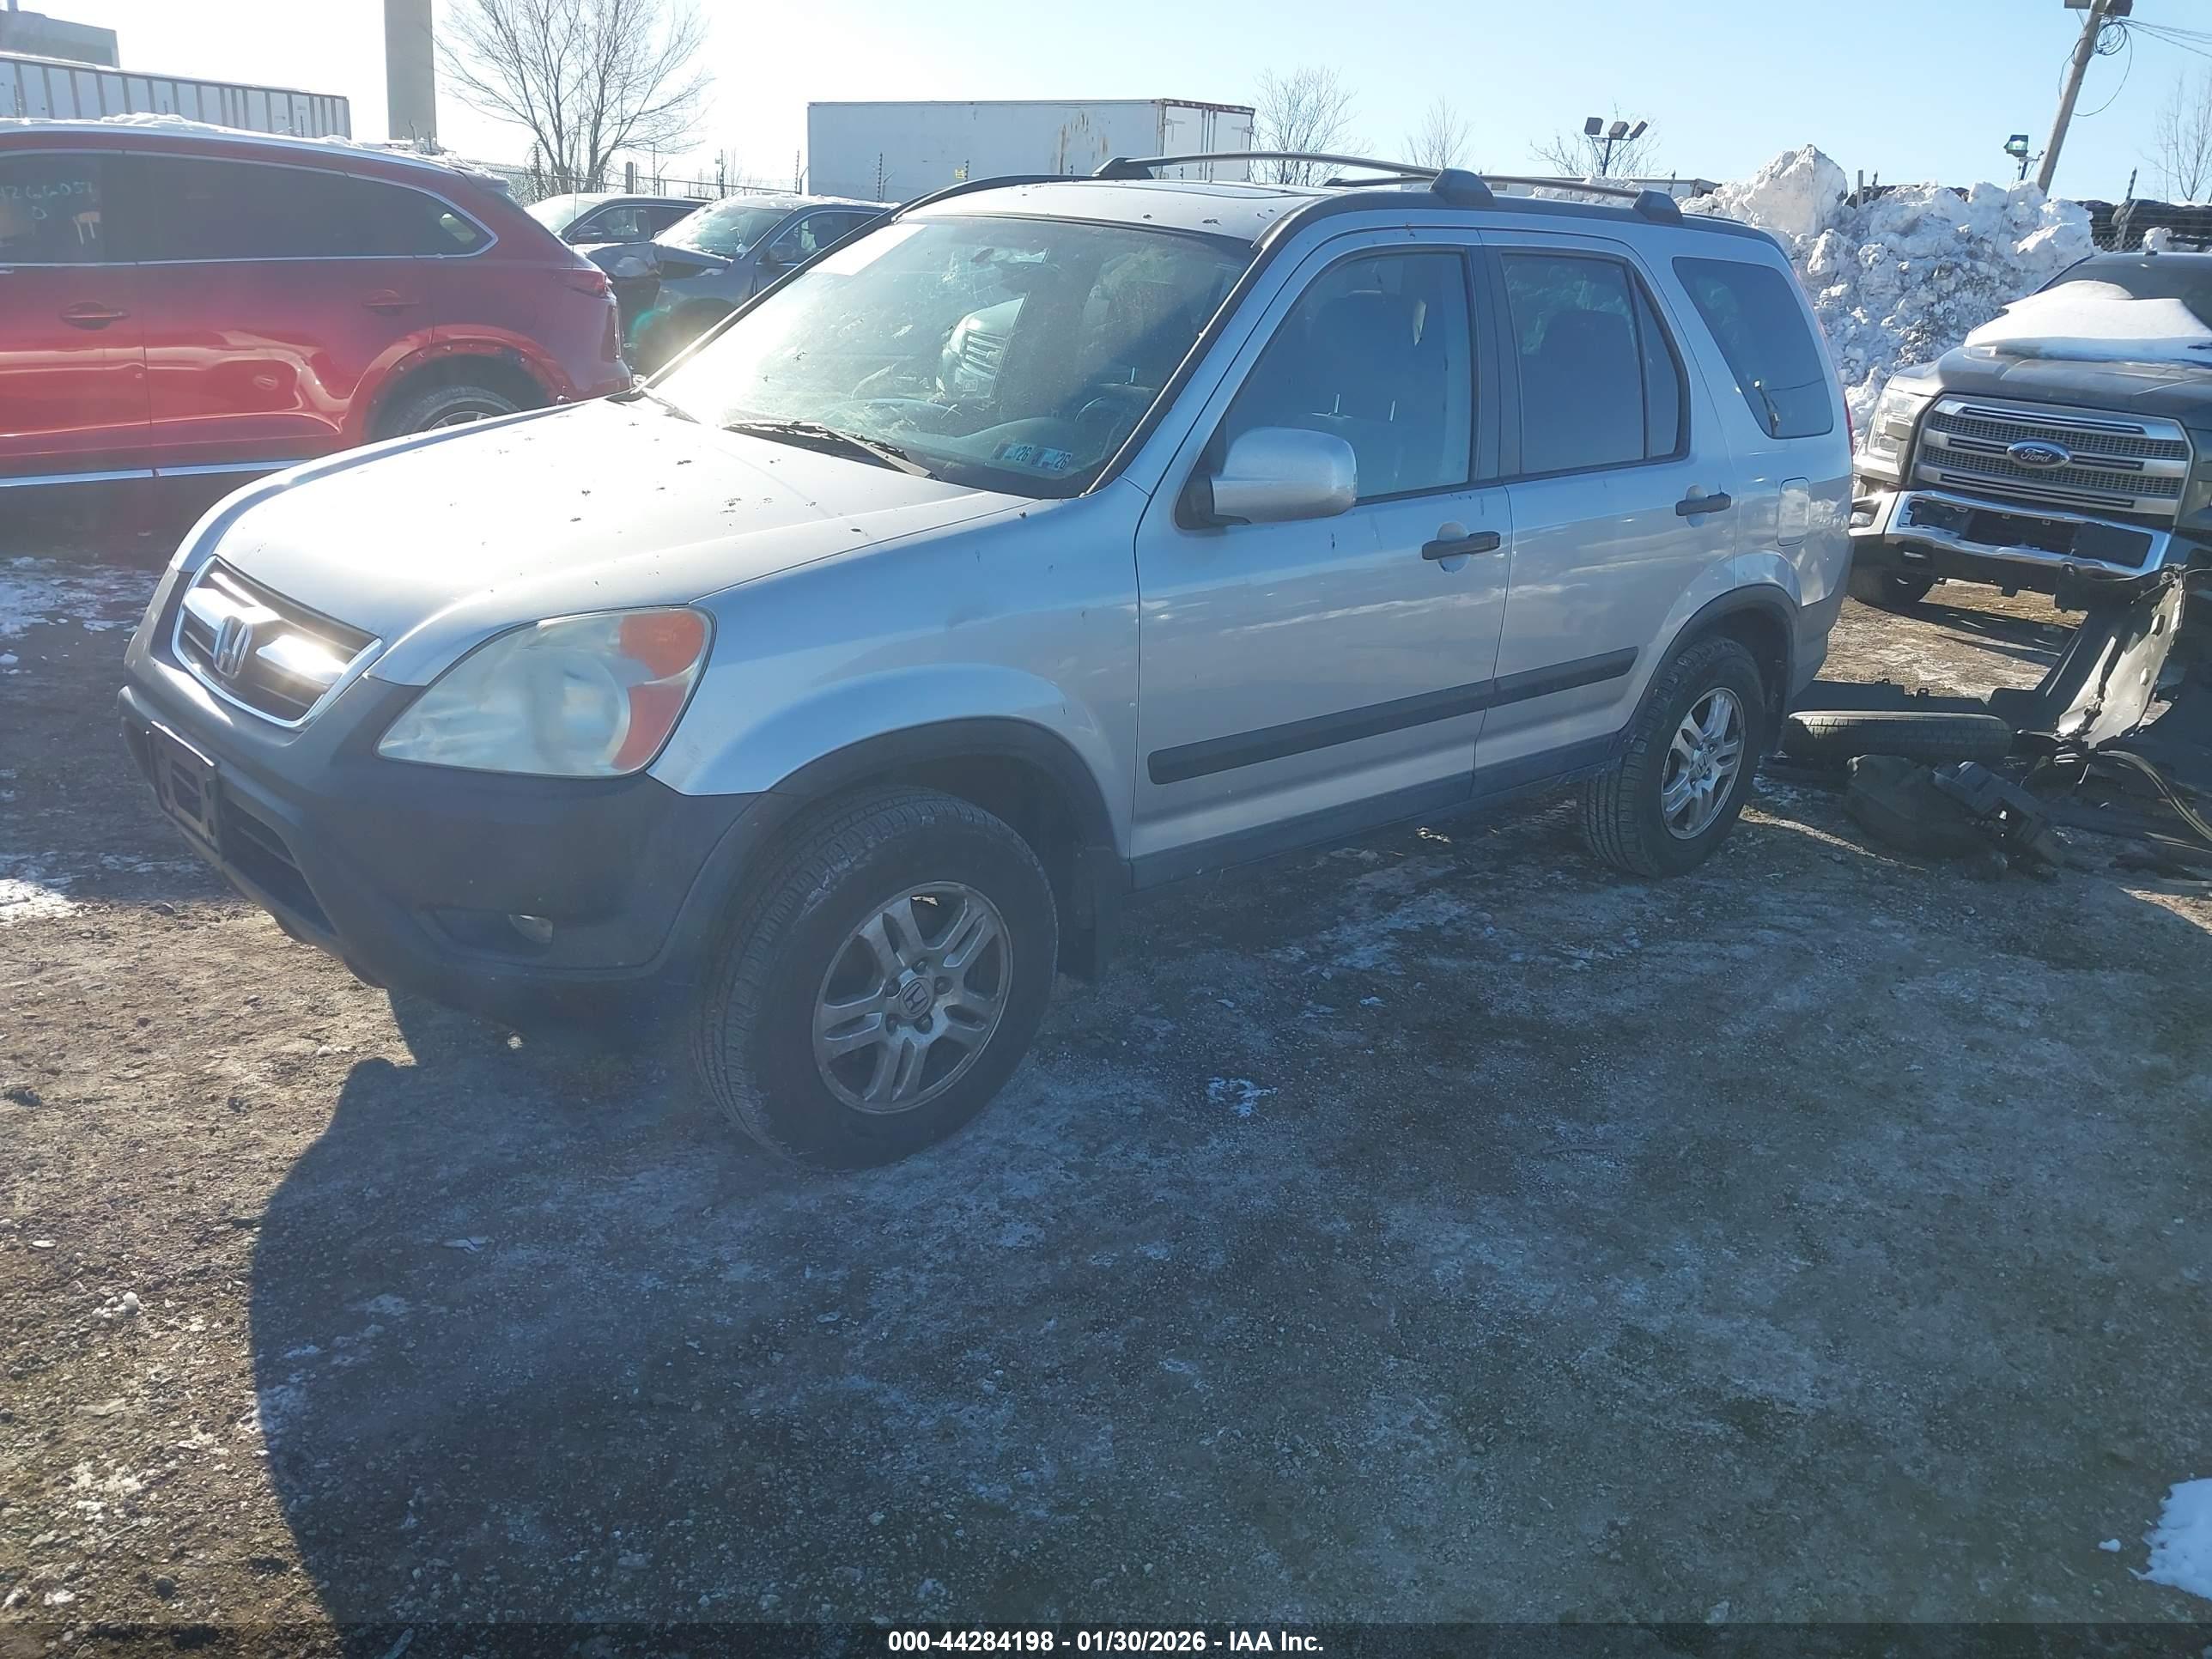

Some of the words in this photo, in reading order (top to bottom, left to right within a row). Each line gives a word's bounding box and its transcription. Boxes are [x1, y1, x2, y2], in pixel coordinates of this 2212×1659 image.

[1016, 446, 1032, 461] 26
[1054, 453, 1072, 469] 26
[2021, 447, 2053, 463] Ford
